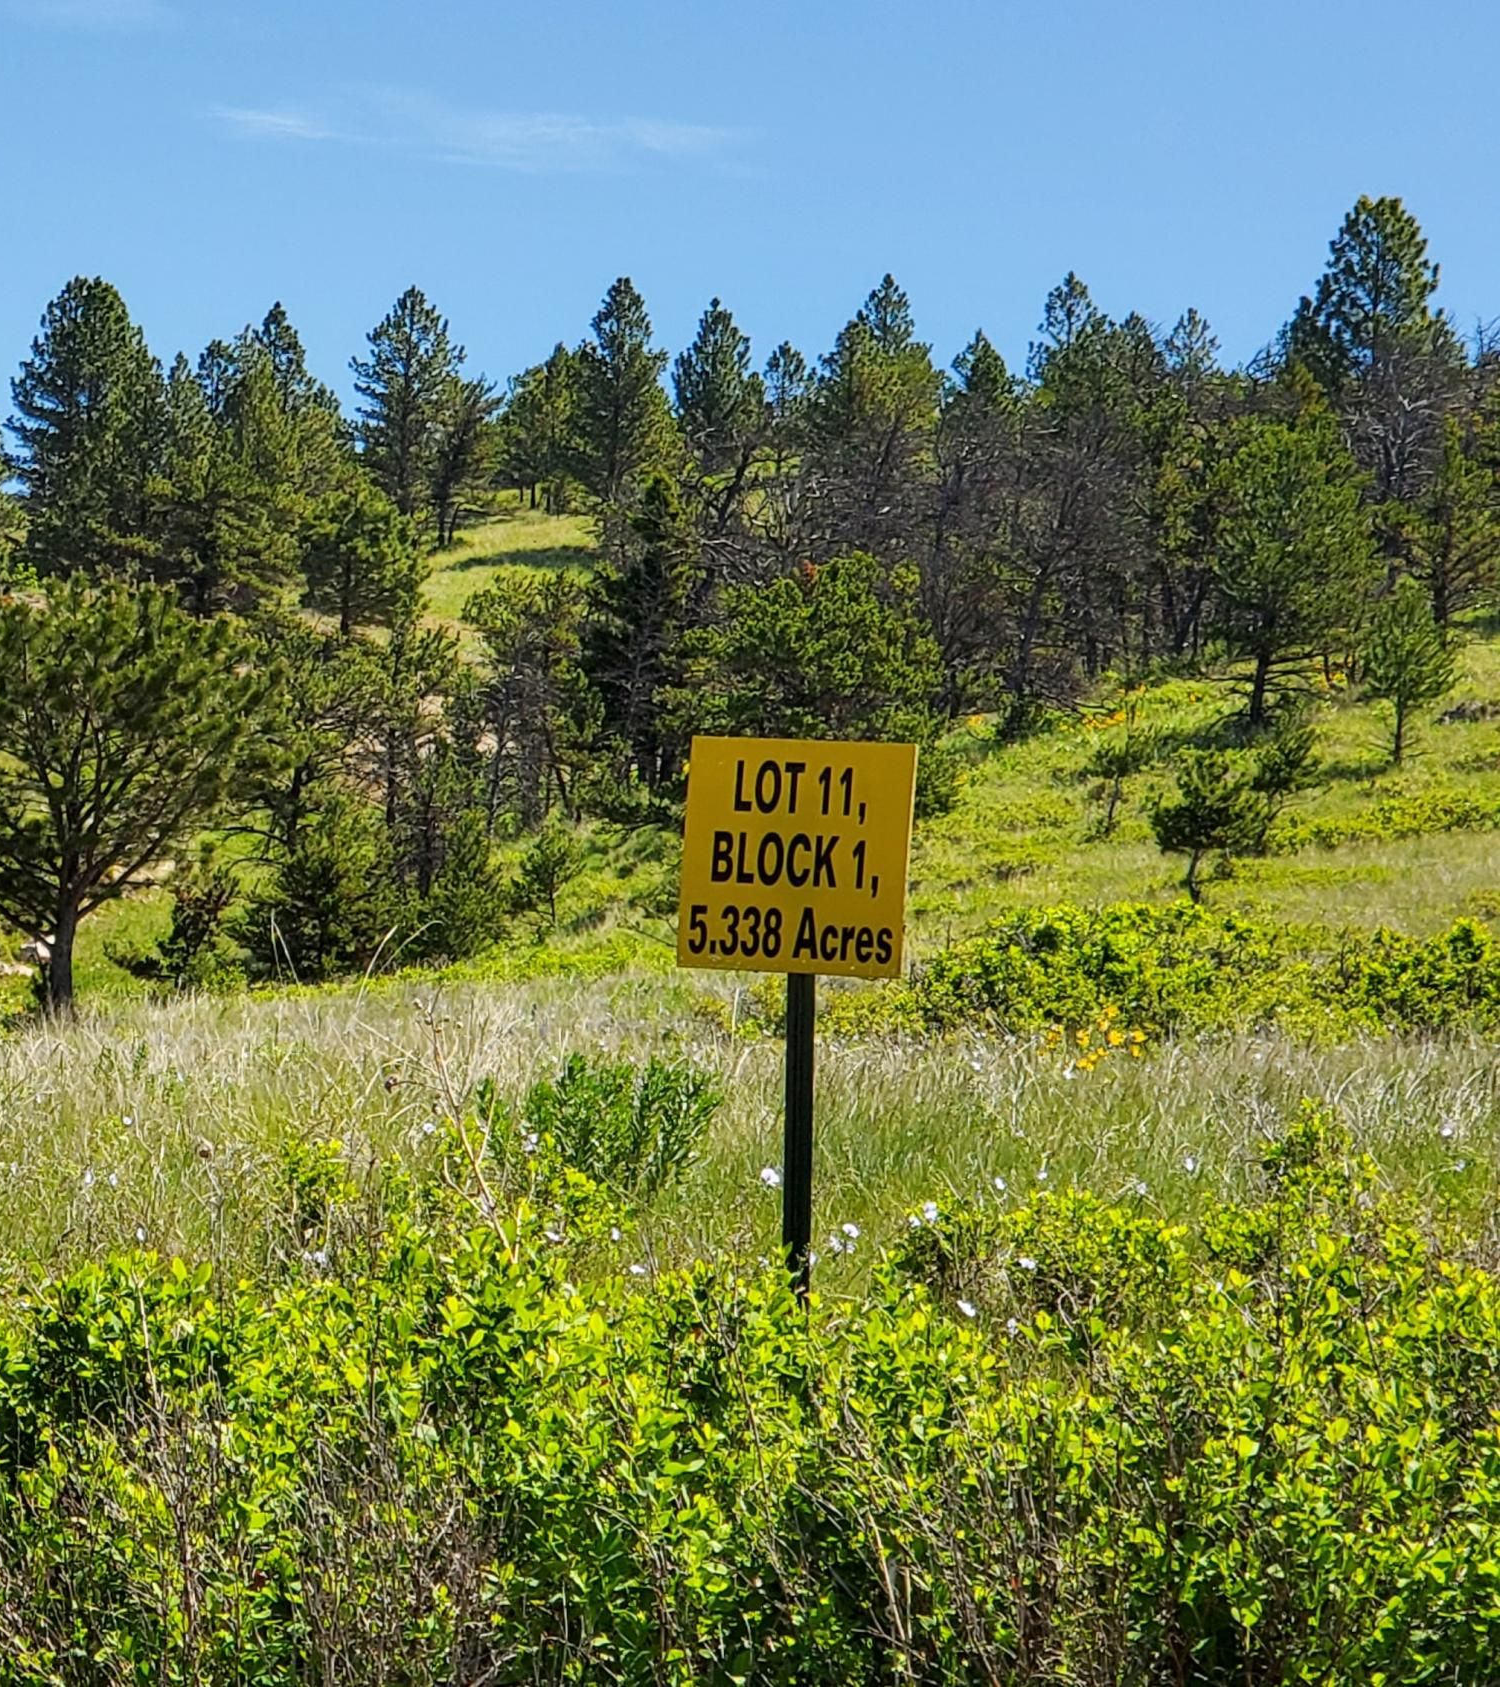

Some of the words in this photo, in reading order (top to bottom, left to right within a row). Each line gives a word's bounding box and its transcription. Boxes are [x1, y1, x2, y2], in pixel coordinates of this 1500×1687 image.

[733, 759, 807, 815] LOT
[818, 766, 867, 825] 11,
[710, 830, 841, 889] BLOCK
[852, 839, 880, 899] 1,
[687, 904, 783, 959] 5.338
[791, 906, 893, 965] Acres
